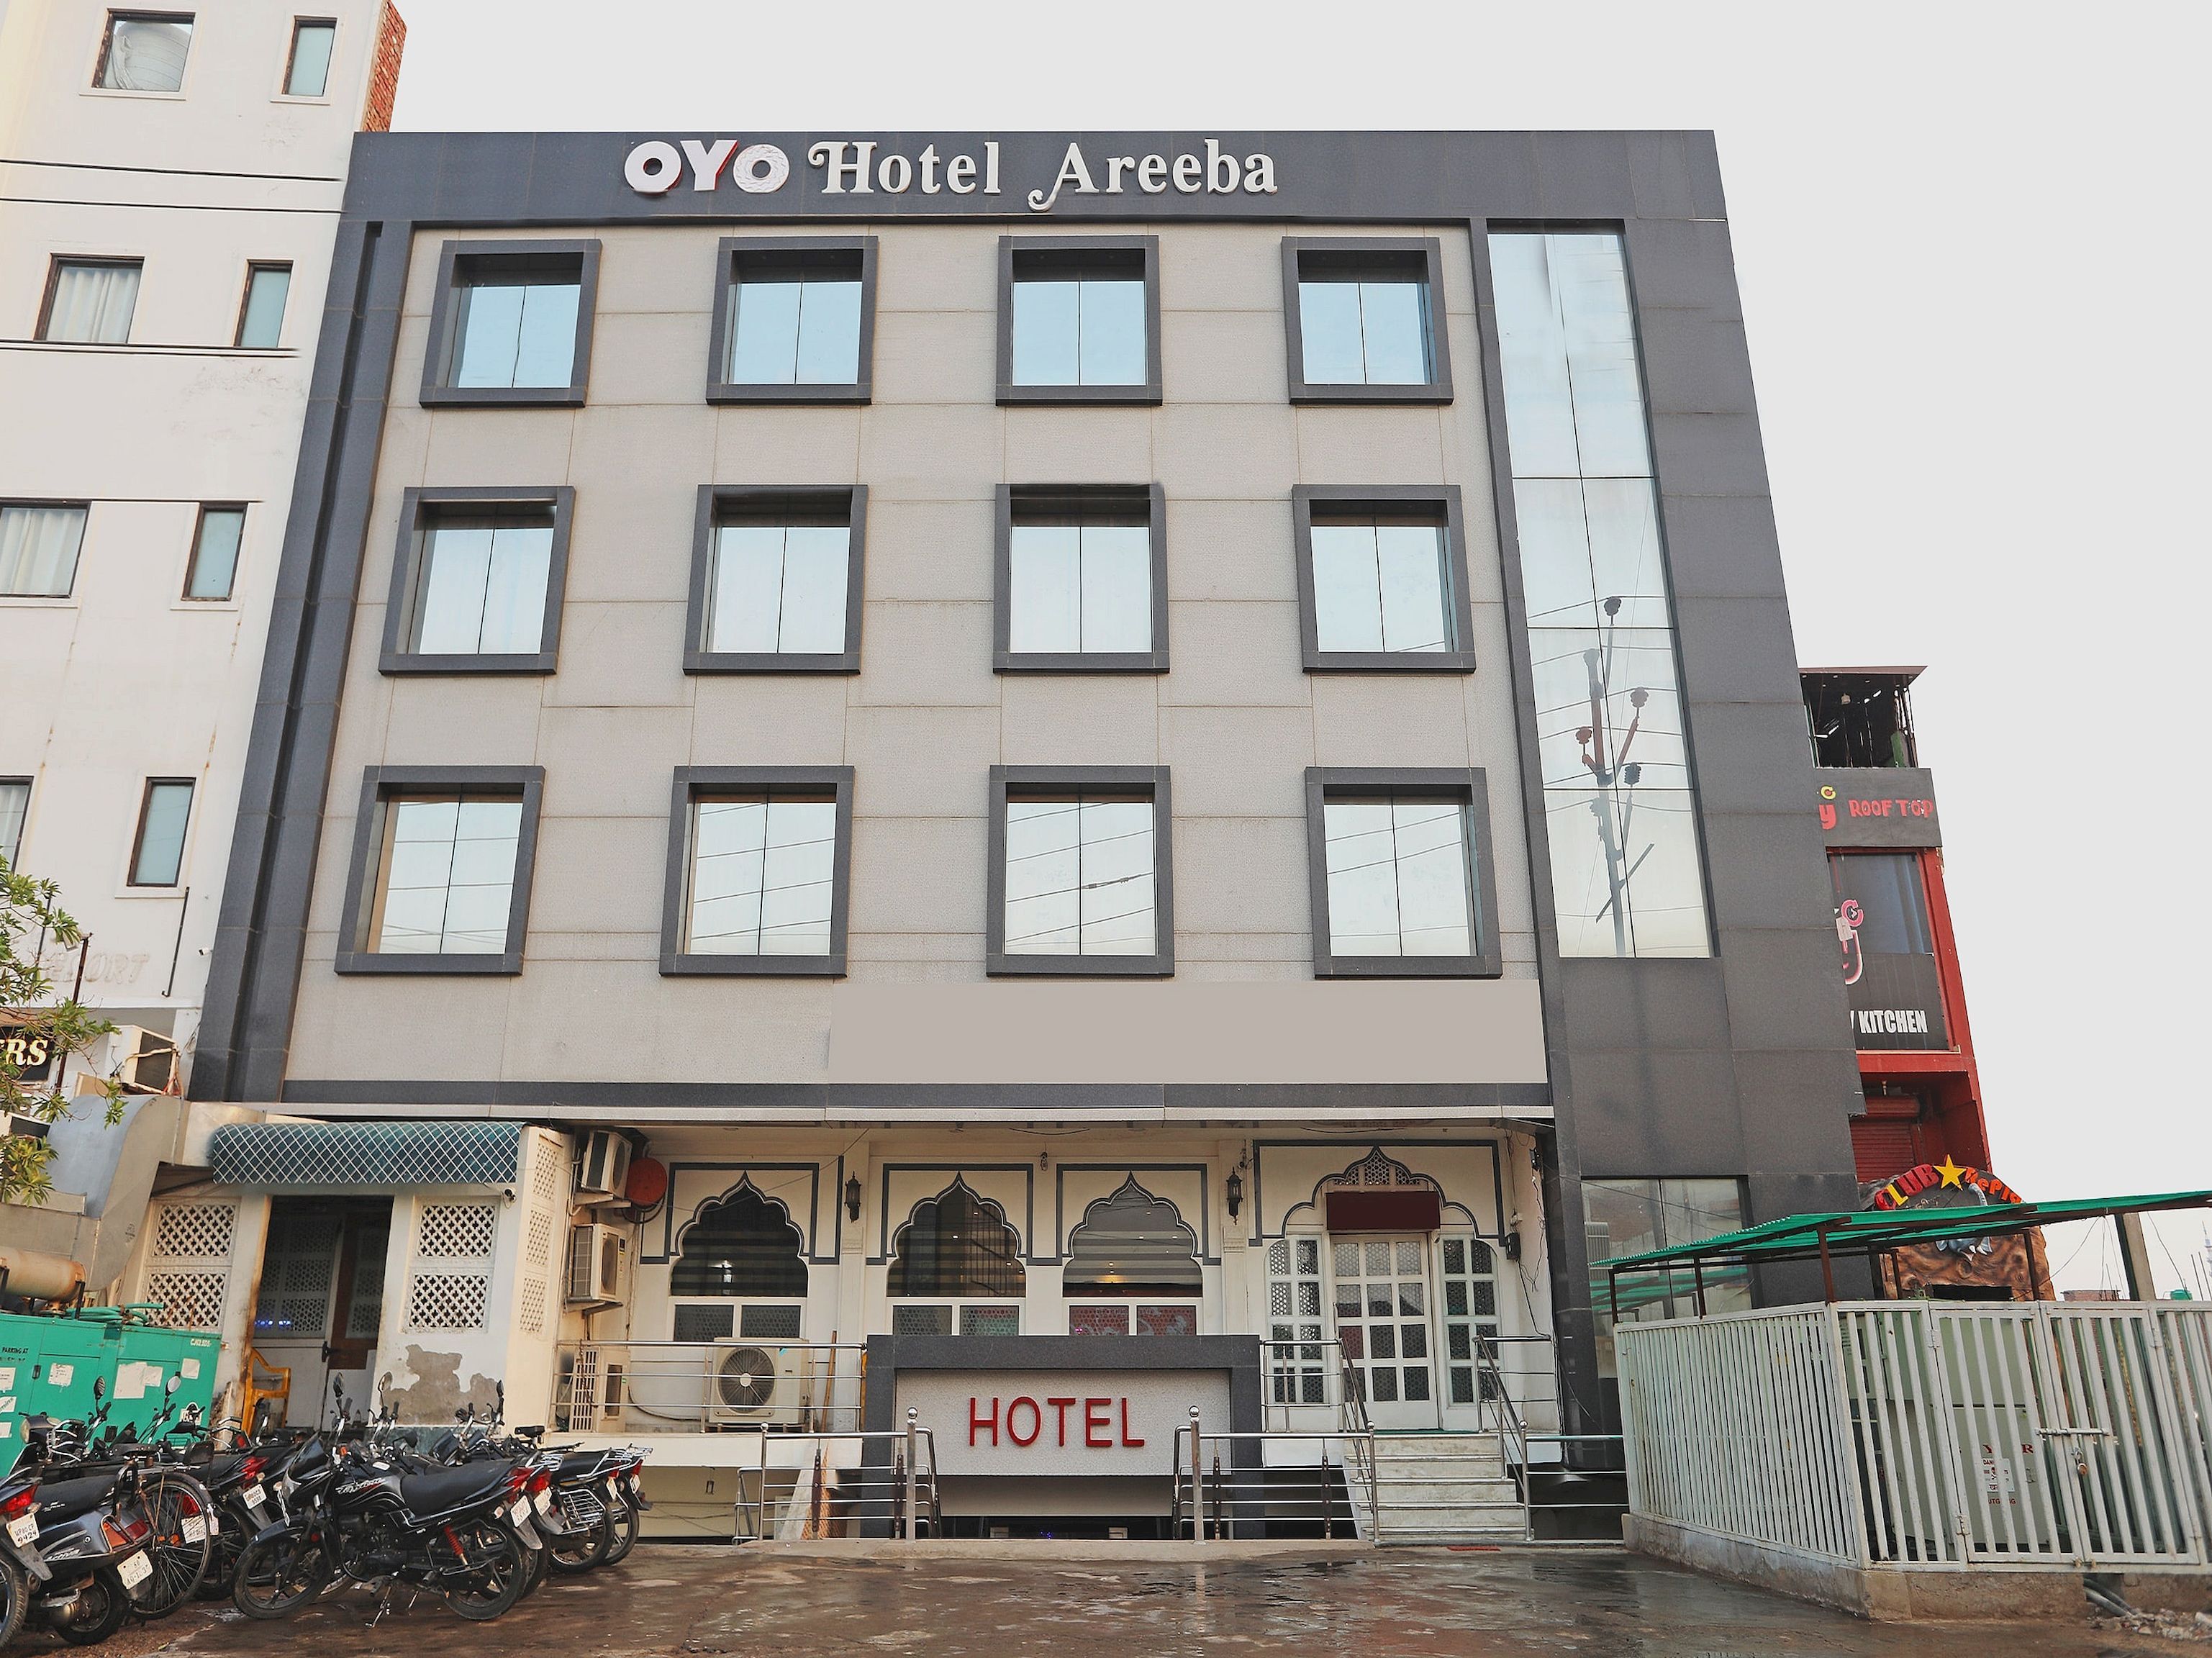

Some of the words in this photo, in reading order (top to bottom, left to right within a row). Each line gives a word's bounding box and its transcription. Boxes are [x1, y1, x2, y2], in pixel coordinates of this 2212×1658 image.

[624, 139, 790, 193] OYO
[808, 141, 1001, 194] Hotel
[1028, 138, 1278, 212] Areeba
[1848, 799, 1893, 817] ROOF
[1895, 799, 1934, 818] TOP
[1858, 1009, 1928, 1034] KITCHEN
[1874, 1163, 1939, 1210] CLUB
[969, 1396, 1146, 1447] HOTEL
